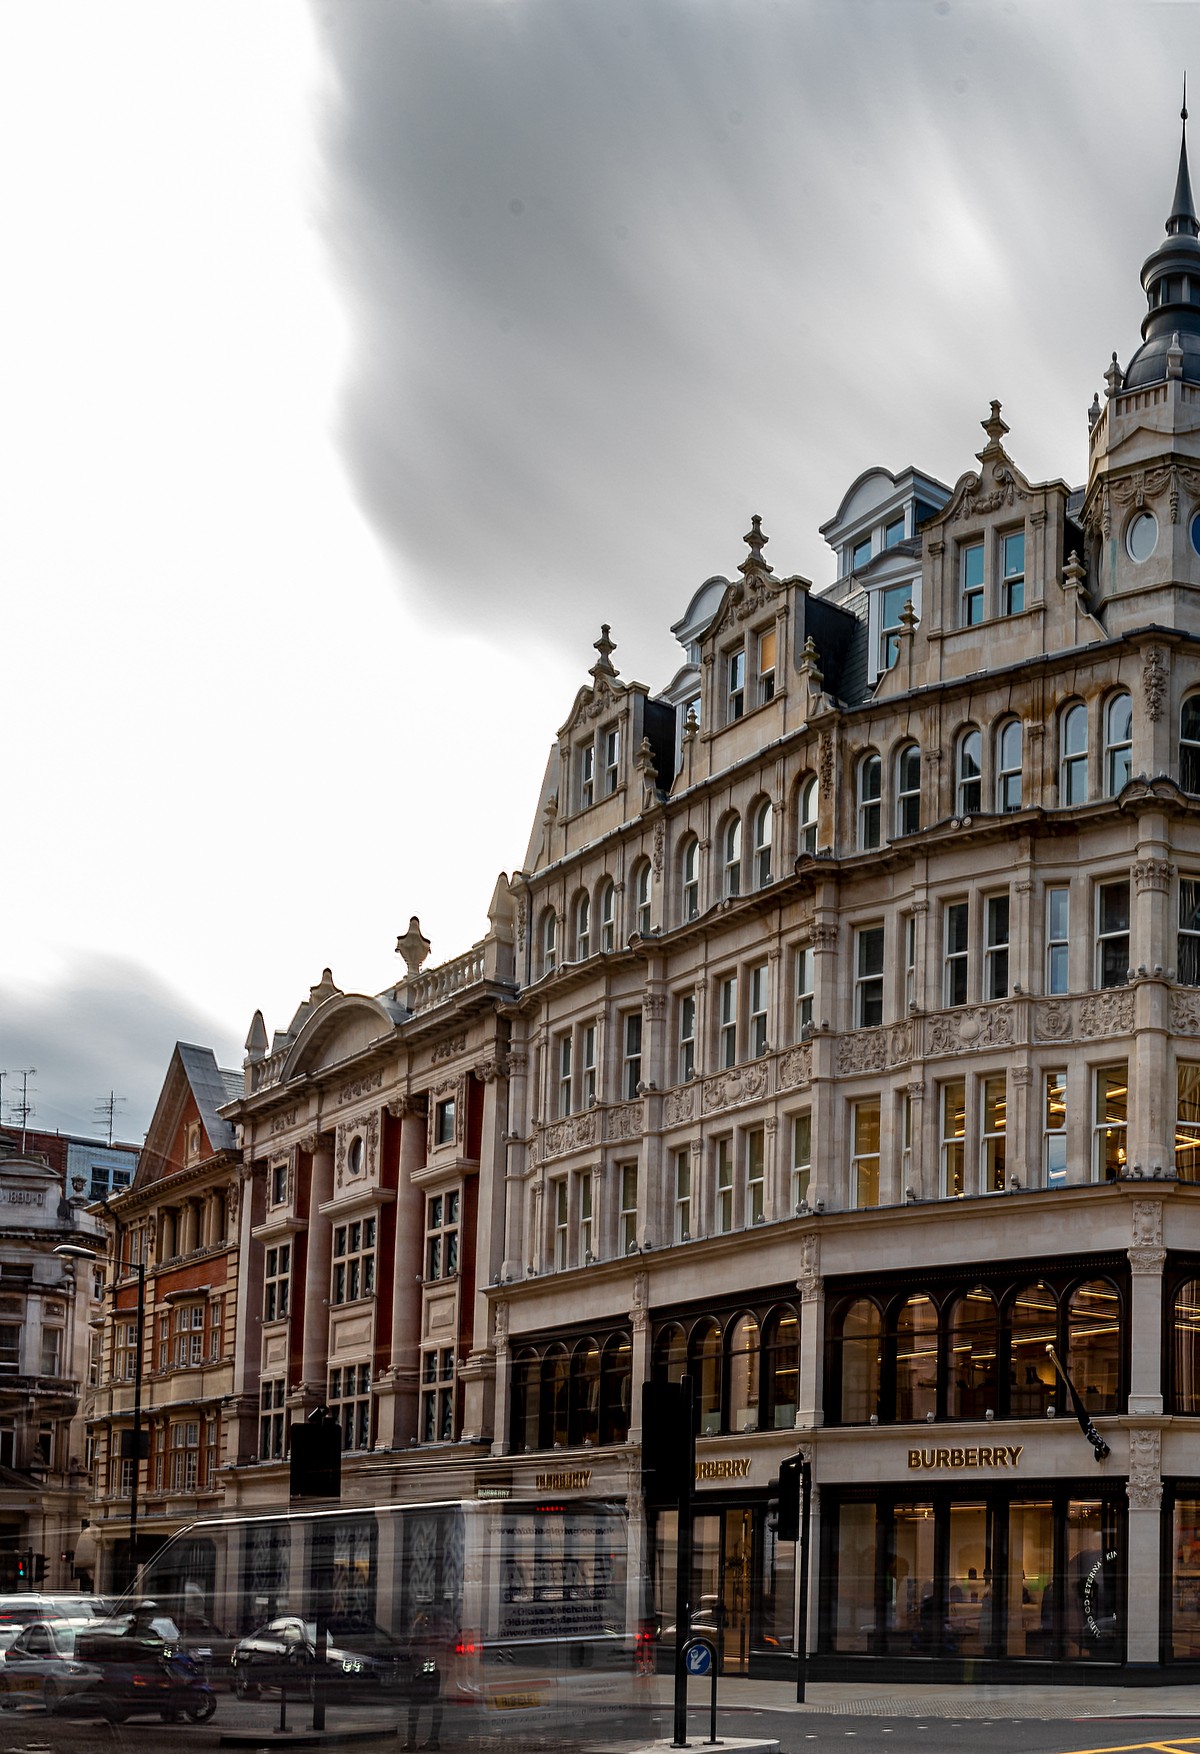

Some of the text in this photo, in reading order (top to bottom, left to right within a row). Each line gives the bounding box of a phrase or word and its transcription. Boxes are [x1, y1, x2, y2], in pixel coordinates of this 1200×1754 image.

[907, 1446, 1024, 1469] BURBERRY
[536, 1471, 593, 1491] BURBERRY
[1084, 1559, 1102, 1594] ETERNA
